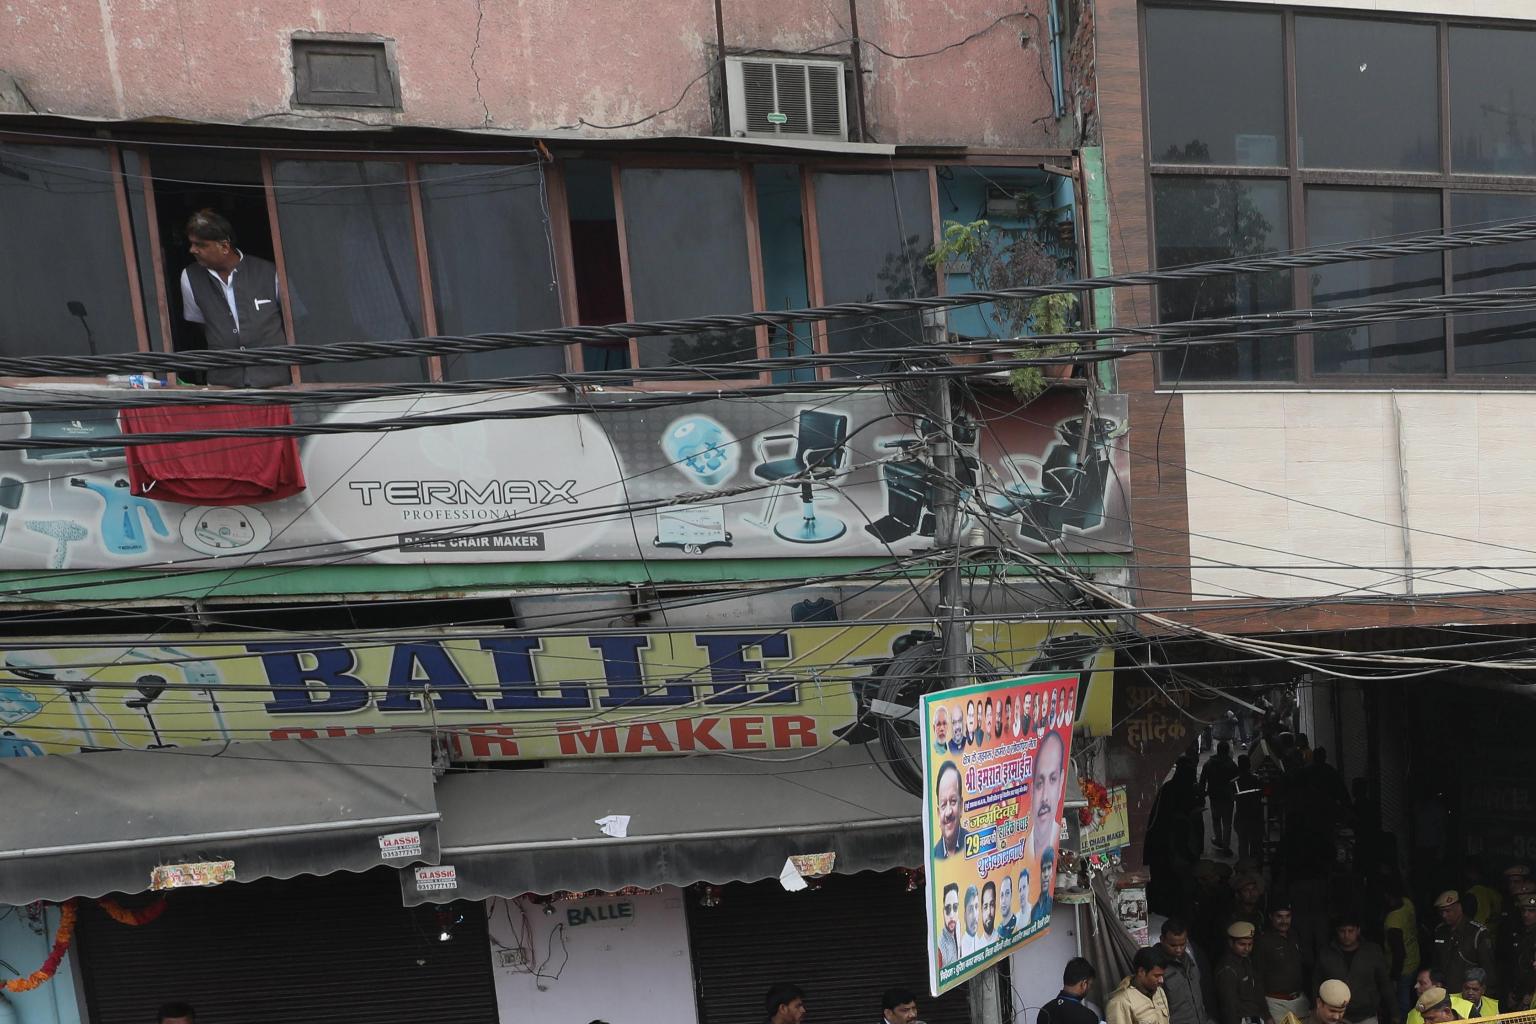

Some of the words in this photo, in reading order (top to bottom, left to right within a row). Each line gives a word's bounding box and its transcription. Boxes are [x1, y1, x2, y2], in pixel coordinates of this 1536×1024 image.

[349, 479, 578, 506] TERMAX
[450, 536, 489, 548] CHAIR
[493, 535, 538, 548] MAKER
[246, 631, 799, 716] BALLE
[556, 714, 818, 756] MAKER
[966, 765, 976, 792] श्री
[969, 803, 1019, 829] जन्मदिवस
[383, 836, 419, 847] CLASSIC
[966, 833, 980, 857] 29
[420, 870, 455, 880] CLASSIC
[567, 903, 633, 926] BALLE
